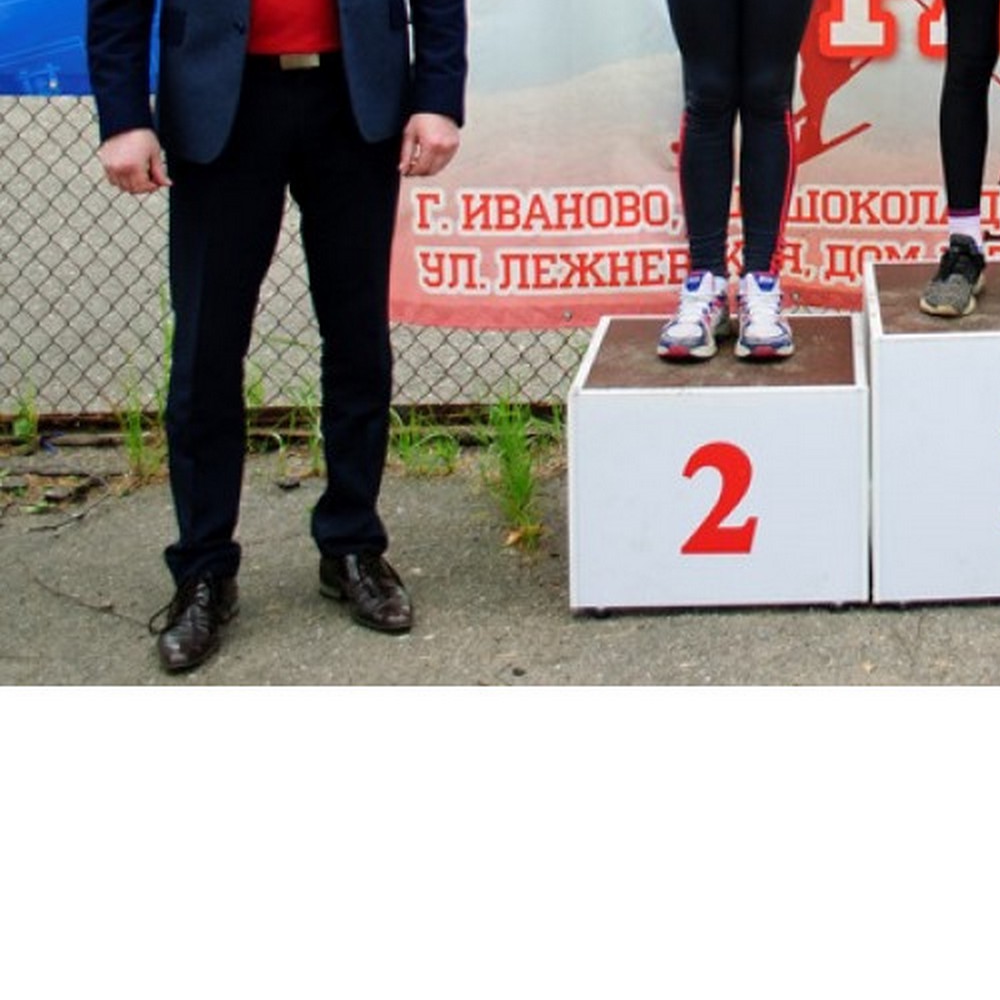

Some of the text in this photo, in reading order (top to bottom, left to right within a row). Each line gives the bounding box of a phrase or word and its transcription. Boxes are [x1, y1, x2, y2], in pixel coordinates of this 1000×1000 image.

[415, 193, 448, 230] Г.
[461, 191, 680, 231] ИВАНОВО,
[419, 252, 486, 288] УЛ.
[680, 441, 759, 555] 2
